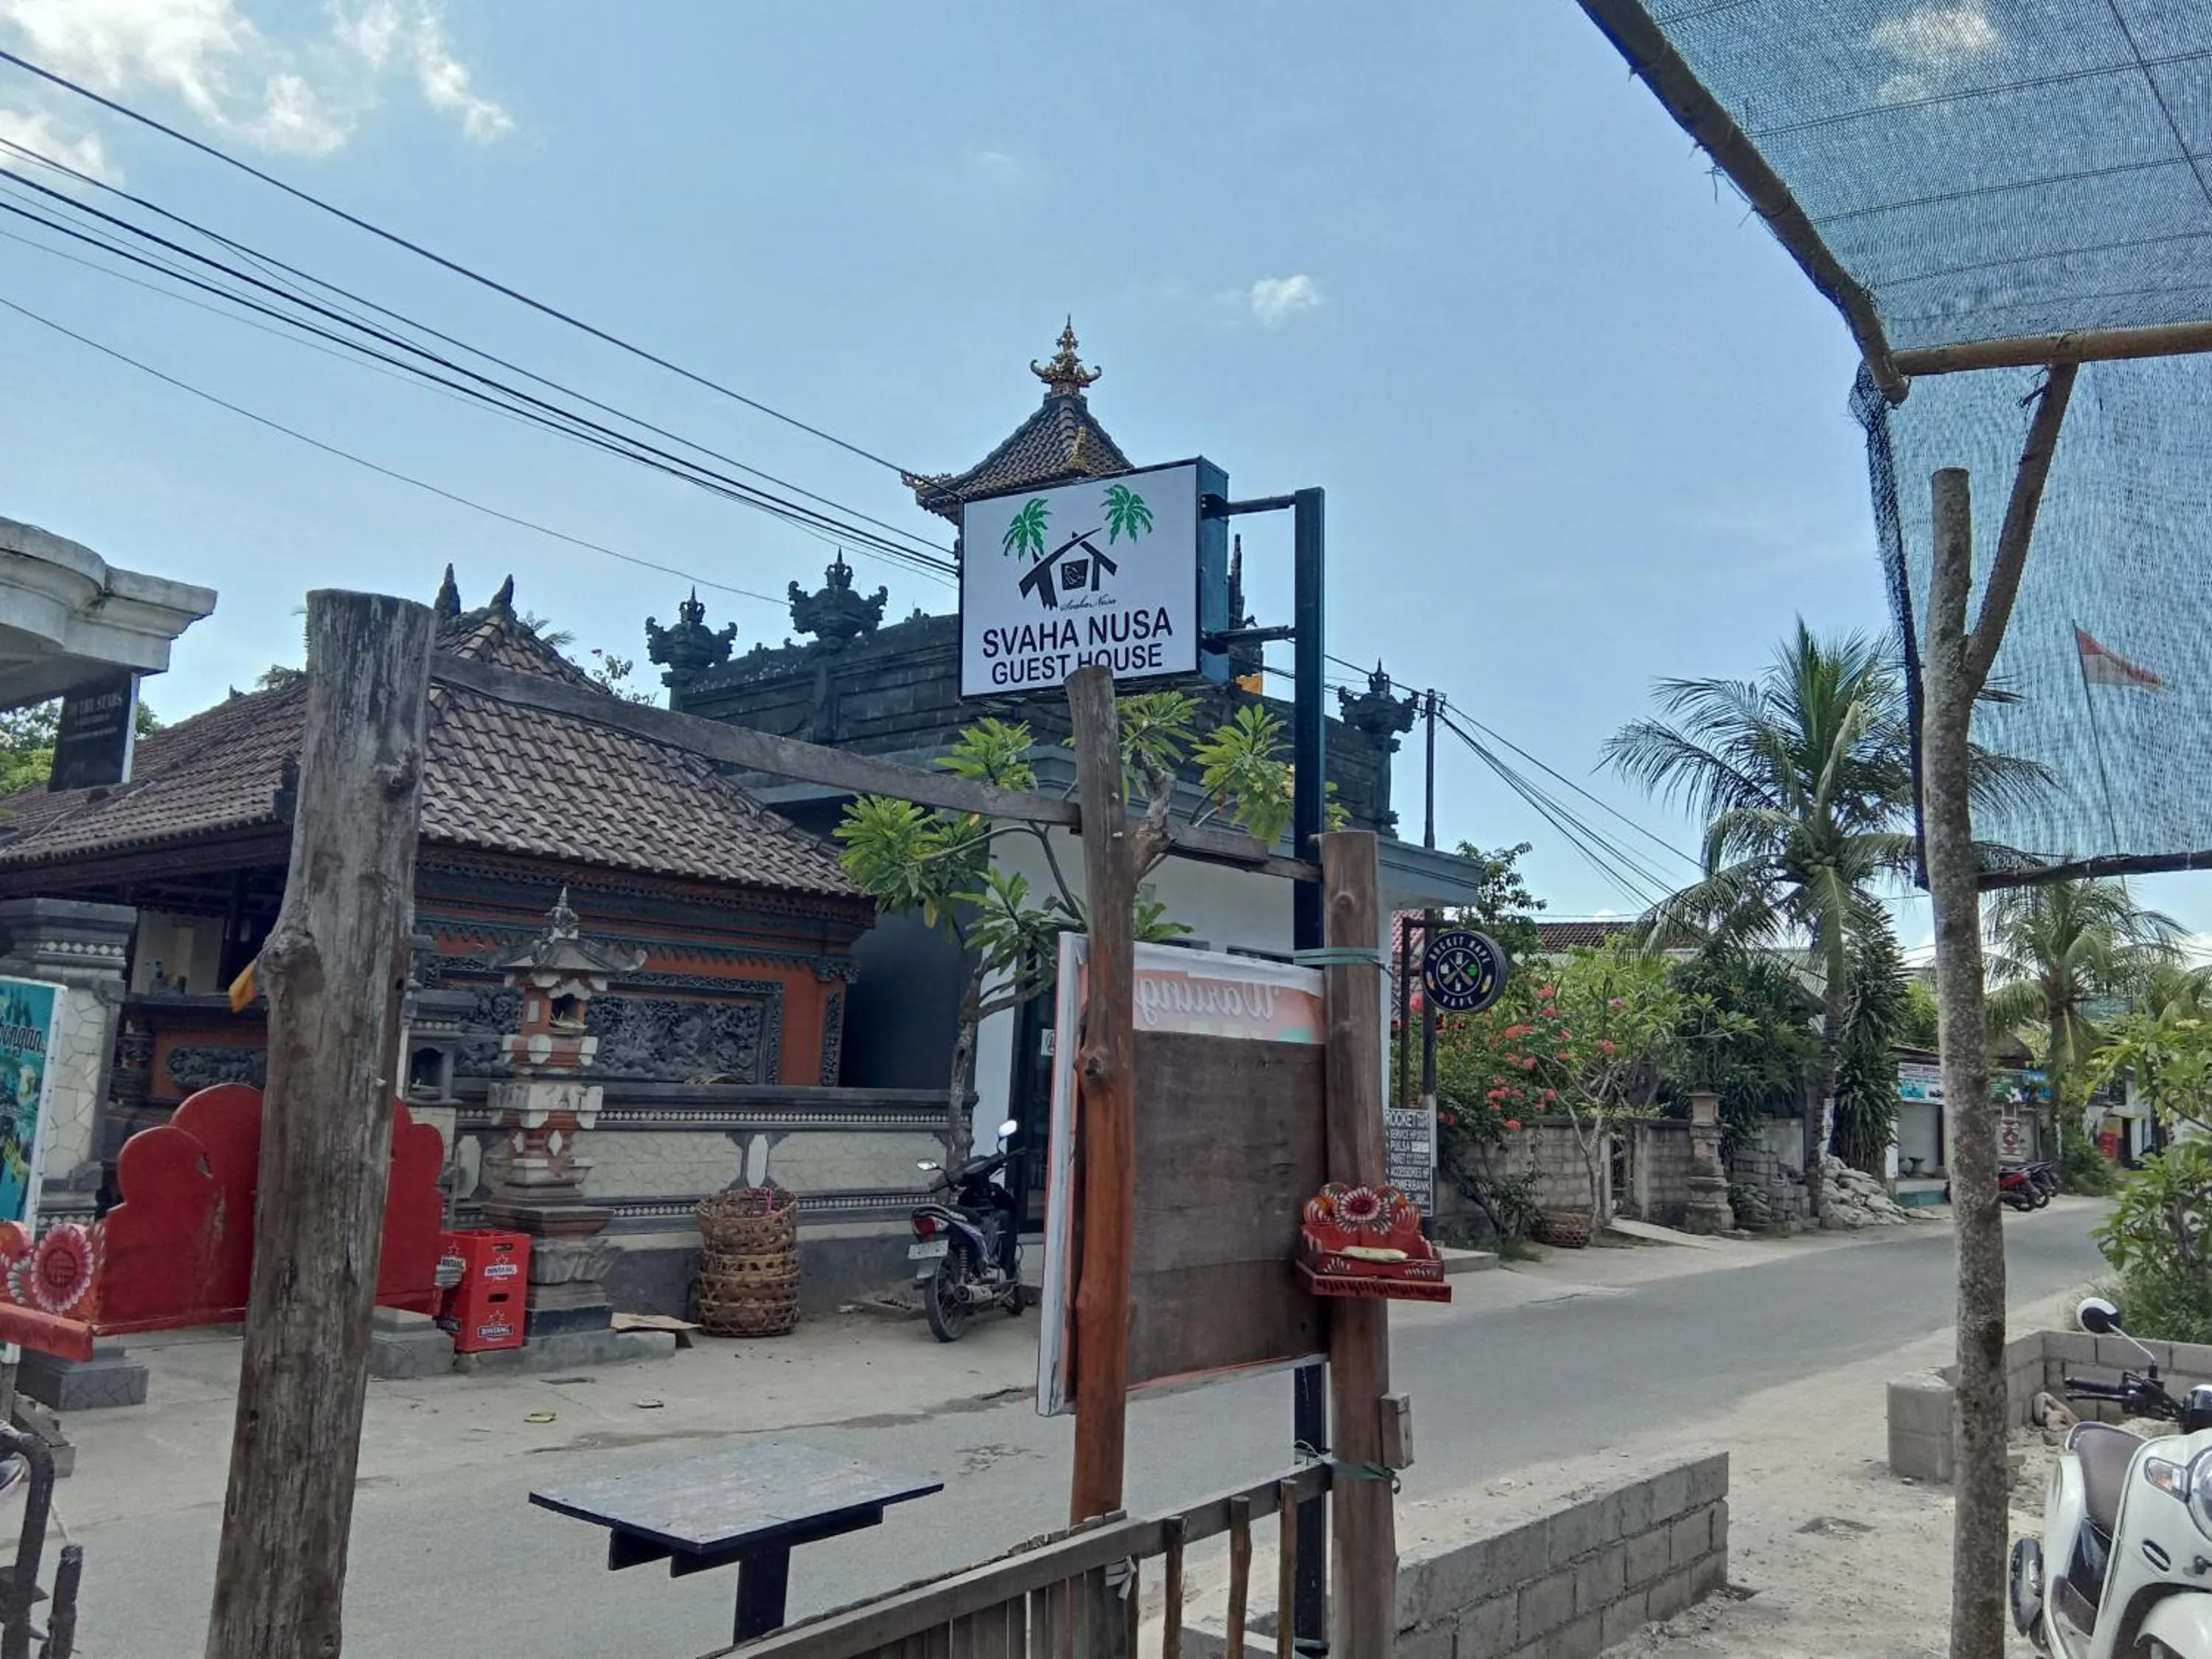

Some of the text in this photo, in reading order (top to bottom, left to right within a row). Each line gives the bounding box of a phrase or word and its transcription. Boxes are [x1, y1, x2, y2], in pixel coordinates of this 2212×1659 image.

[981, 606, 1173, 659] SVAHA NUSA
[992, 642, 1163, 685] GUEST HOUSE
